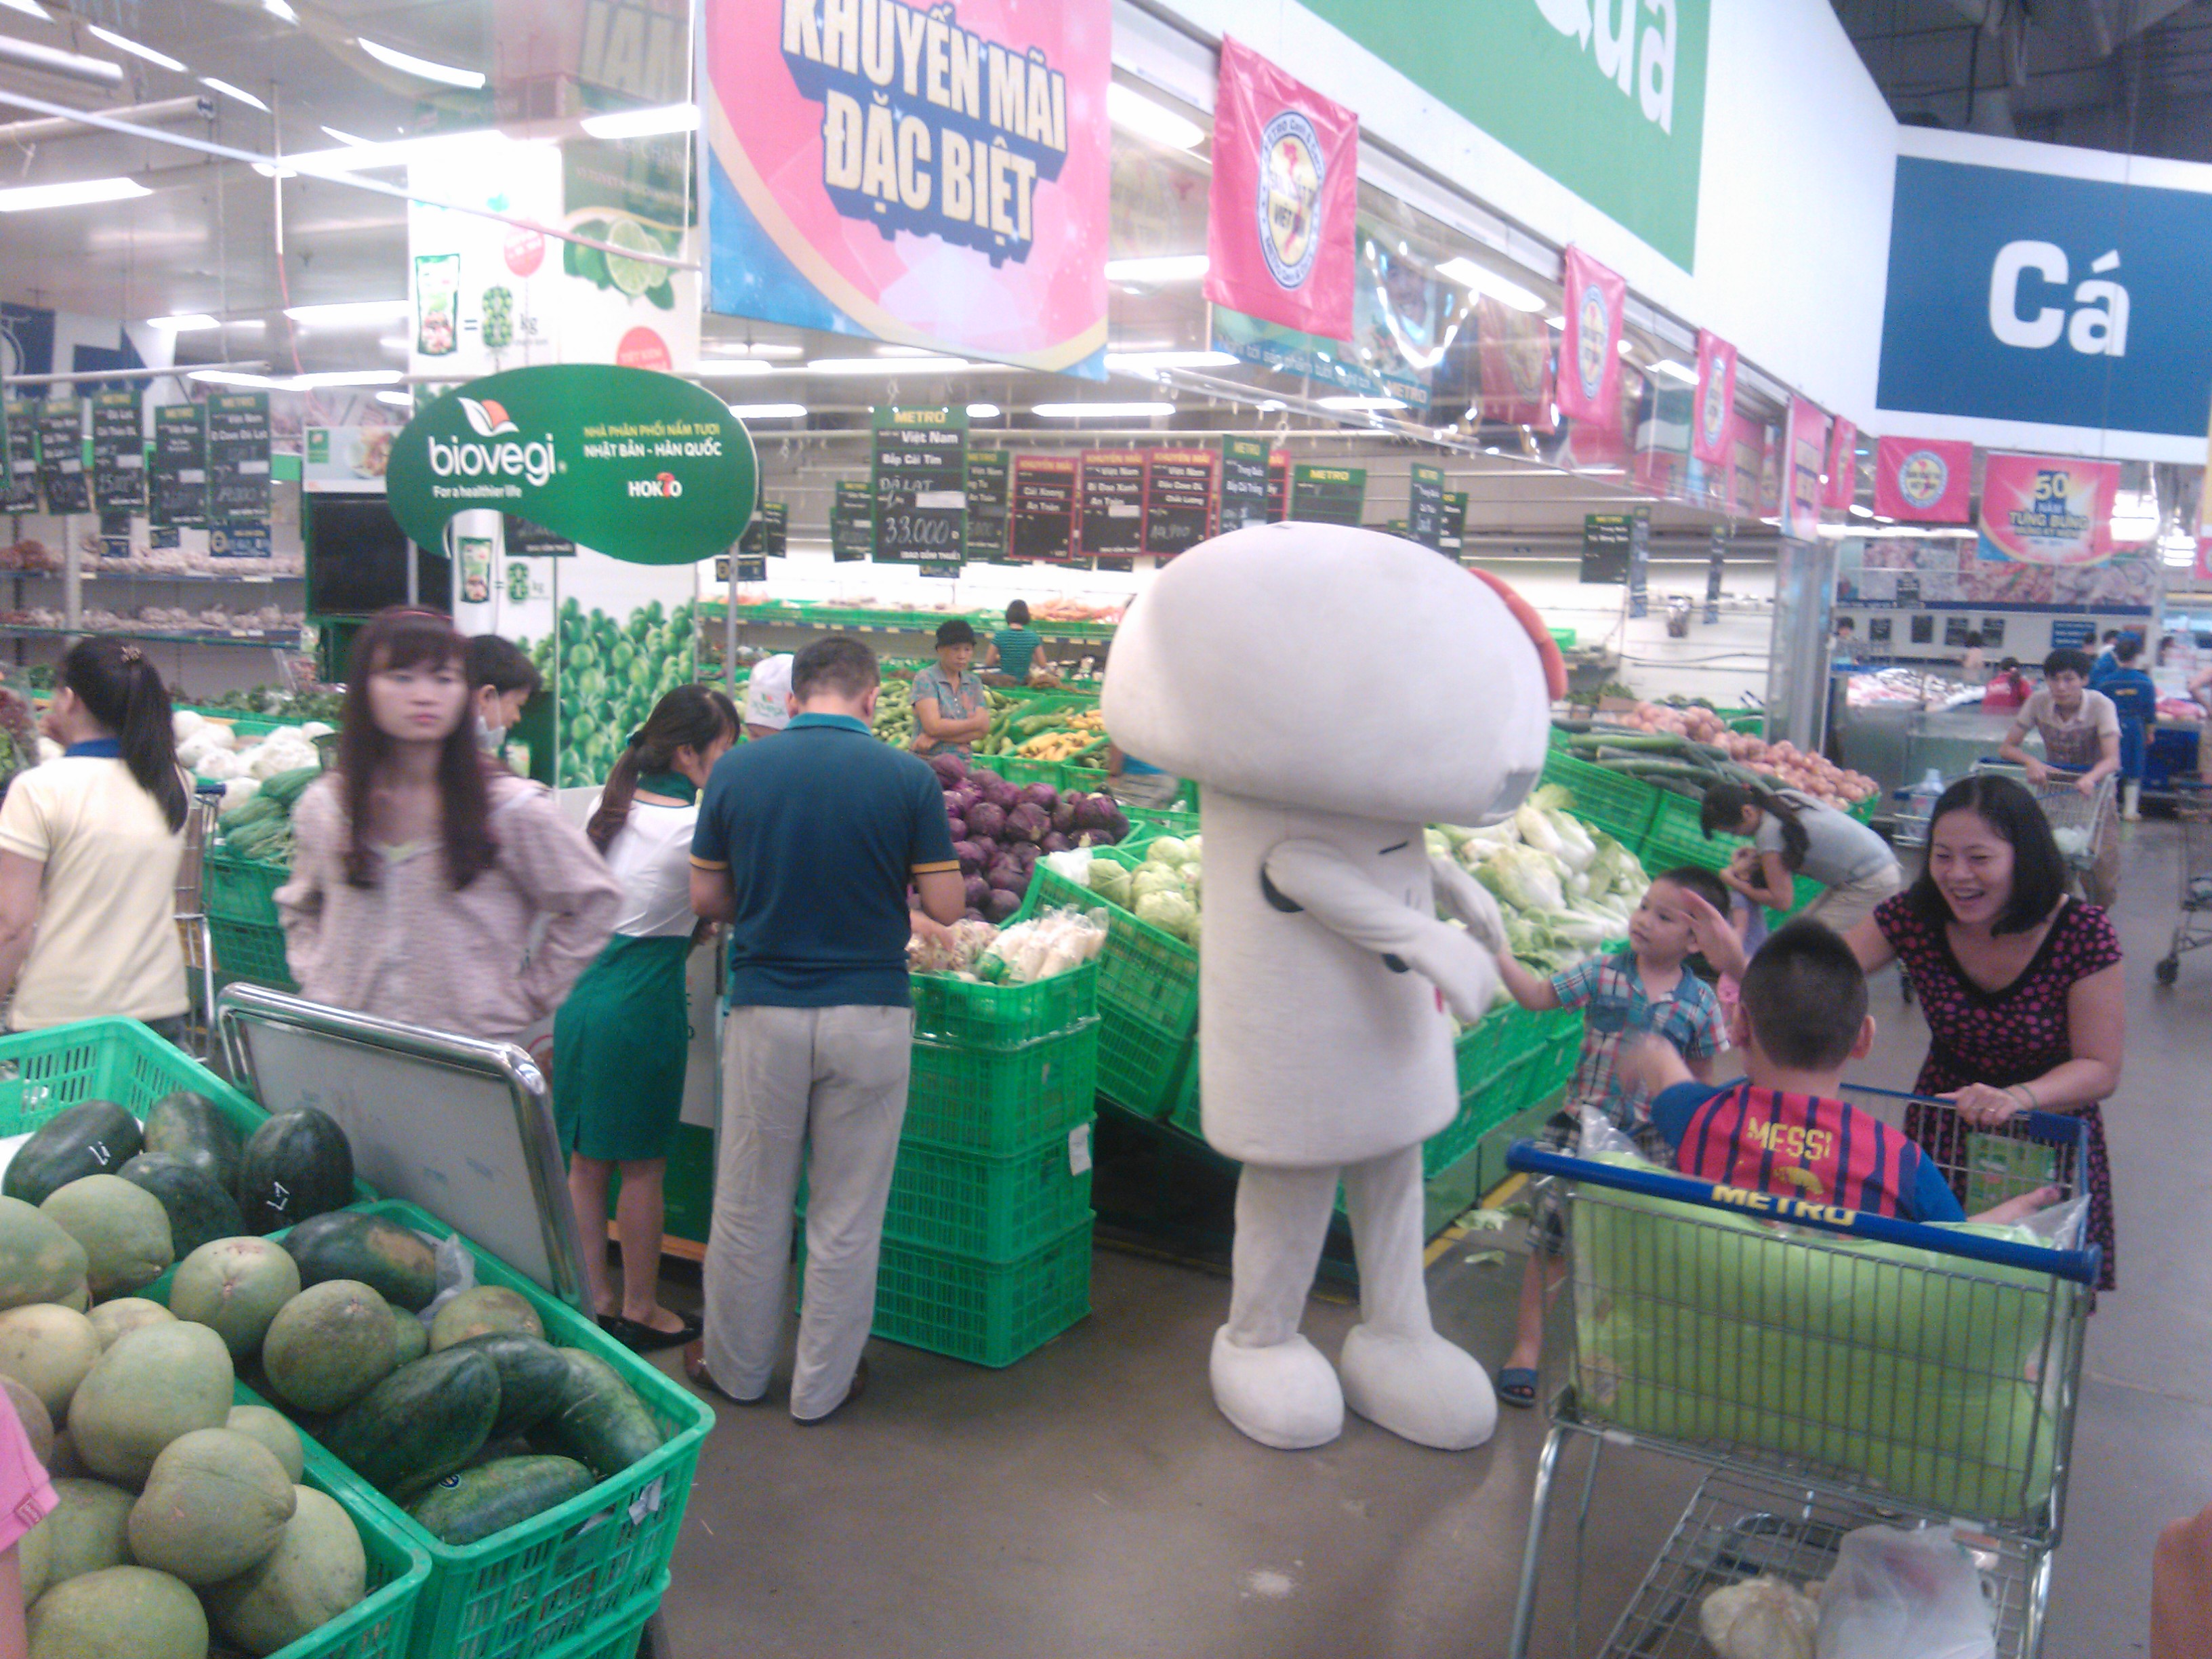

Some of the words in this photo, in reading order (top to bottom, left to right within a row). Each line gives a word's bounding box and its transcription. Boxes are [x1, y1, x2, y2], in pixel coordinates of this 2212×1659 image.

[989, 46, 1067, 153] MÃI
[823, 89, 932, 213] ĐẶC
[941, 128, 1037, 246] BIỆT
[1988, 239, 2131, 358] Cá
[894, 411, 946, 424] METRO
[928, 431, 958, 444] Nam
[428, 432, 556, 487] biovegi
[583, 441, 617, 460] NHẬT
[1309, 469, 1350, 482] METRO
[2035, 472, 2068, 501] 50
[1746, 1117, 1832, 1161] MESSI
[1711, 1185, 1856, 1227] METRO
